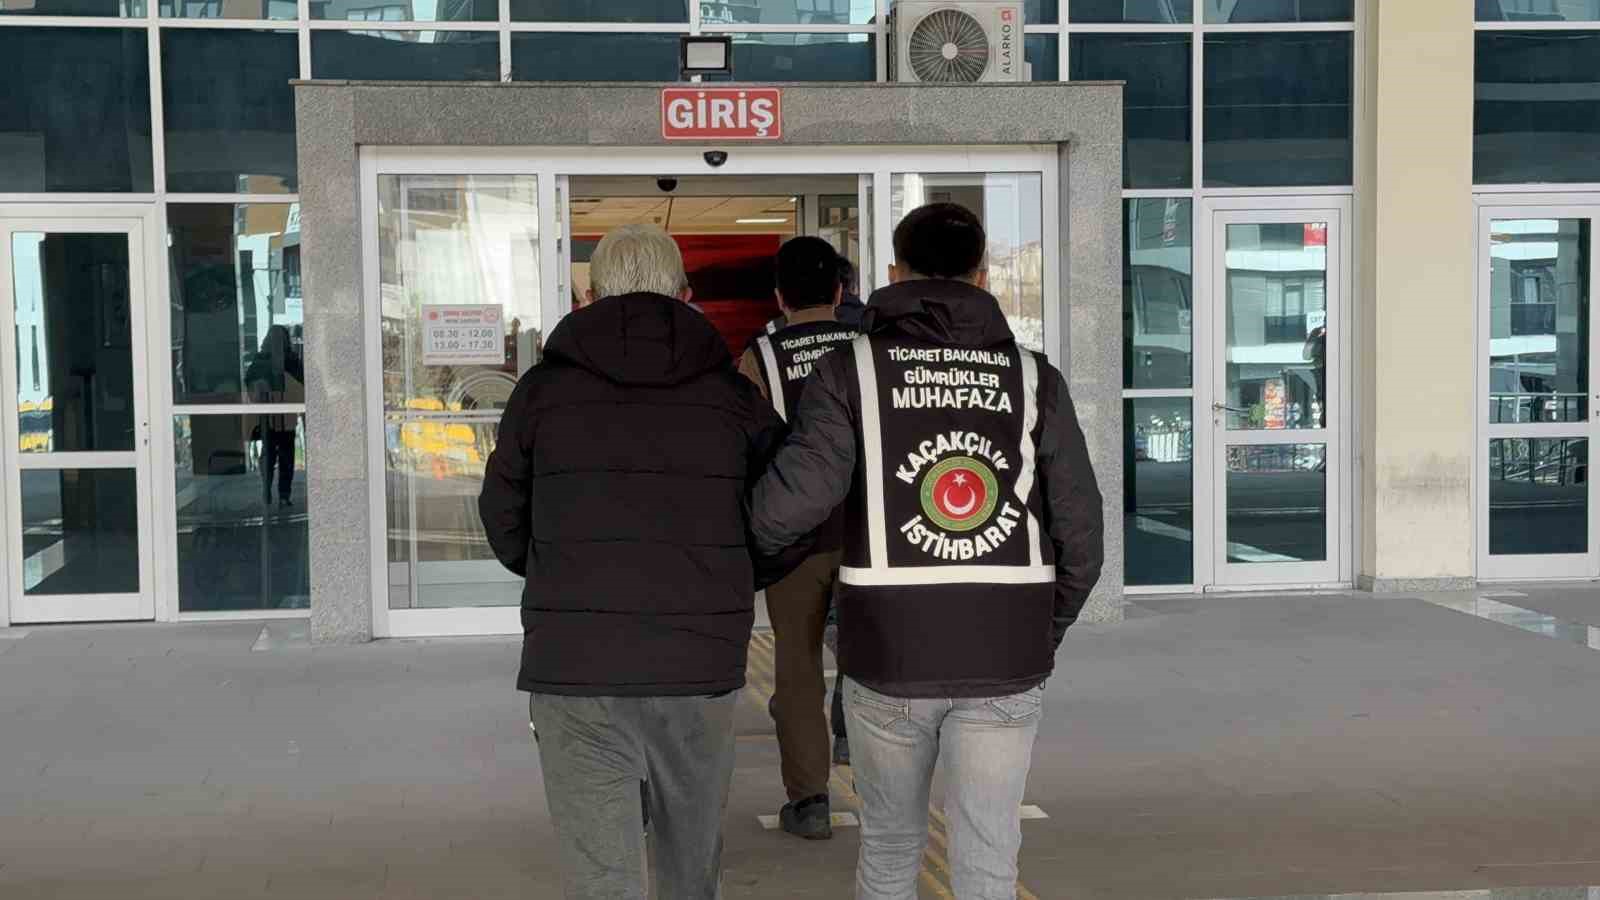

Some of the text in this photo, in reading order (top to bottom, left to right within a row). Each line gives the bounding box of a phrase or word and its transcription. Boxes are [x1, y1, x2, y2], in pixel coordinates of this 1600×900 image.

[1001, 24, 1012, 75] ALARKO
[667, 92, 775, 137] GİRİŞ
[781, 333, 816, 350] TİCARET
[887, 346, 1011, 367] TİCARET BAKANLIĞI
[904, 366, 1000, 388] GÜMRÜKLER
[892, 387, 1013, 414] MUHAFAZA
